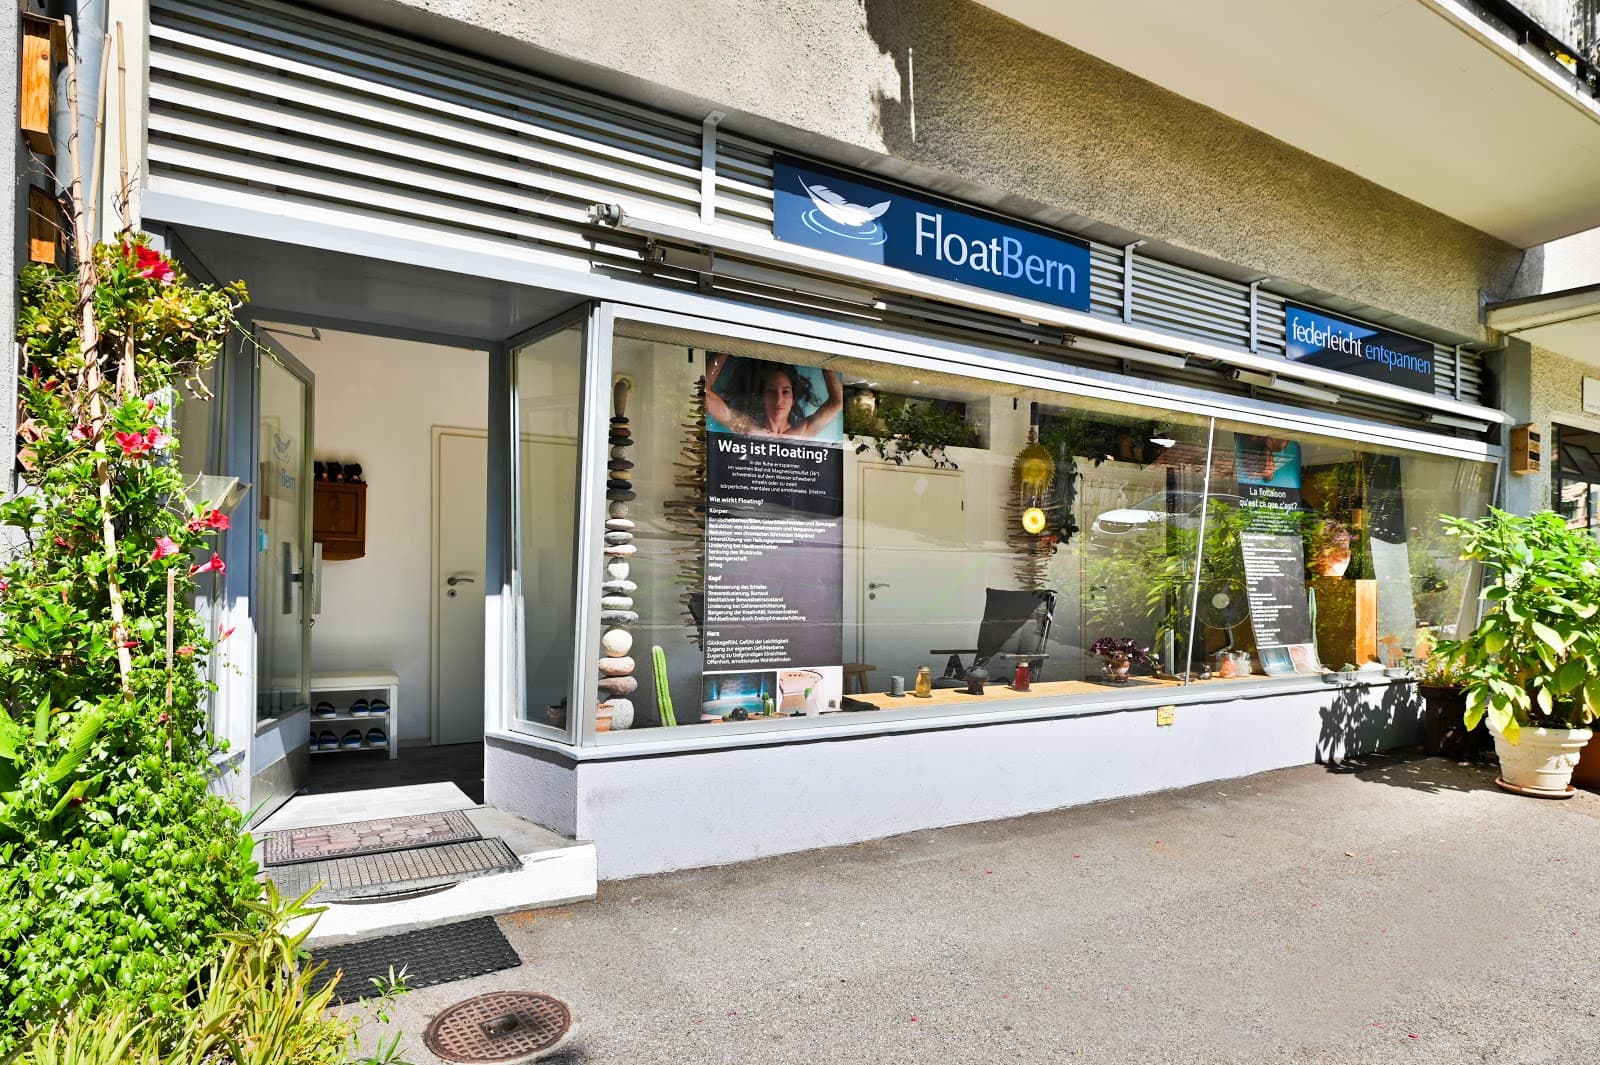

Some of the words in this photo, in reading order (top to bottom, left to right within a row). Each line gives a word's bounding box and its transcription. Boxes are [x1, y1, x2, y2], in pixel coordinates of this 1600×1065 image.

[915, 210, 1076, 294] FloatBern
[1292, 316, 1363, 358] federleicht
[1365, 344, 1431, 375] entspannen
[718, 440, 746, 453] Was
[750, 442, 766, 456] ist
[769, 444, 828, 463] Floating?
[1249, 487, 1258, 496] La
[1267, 502, 1278, 510] que
